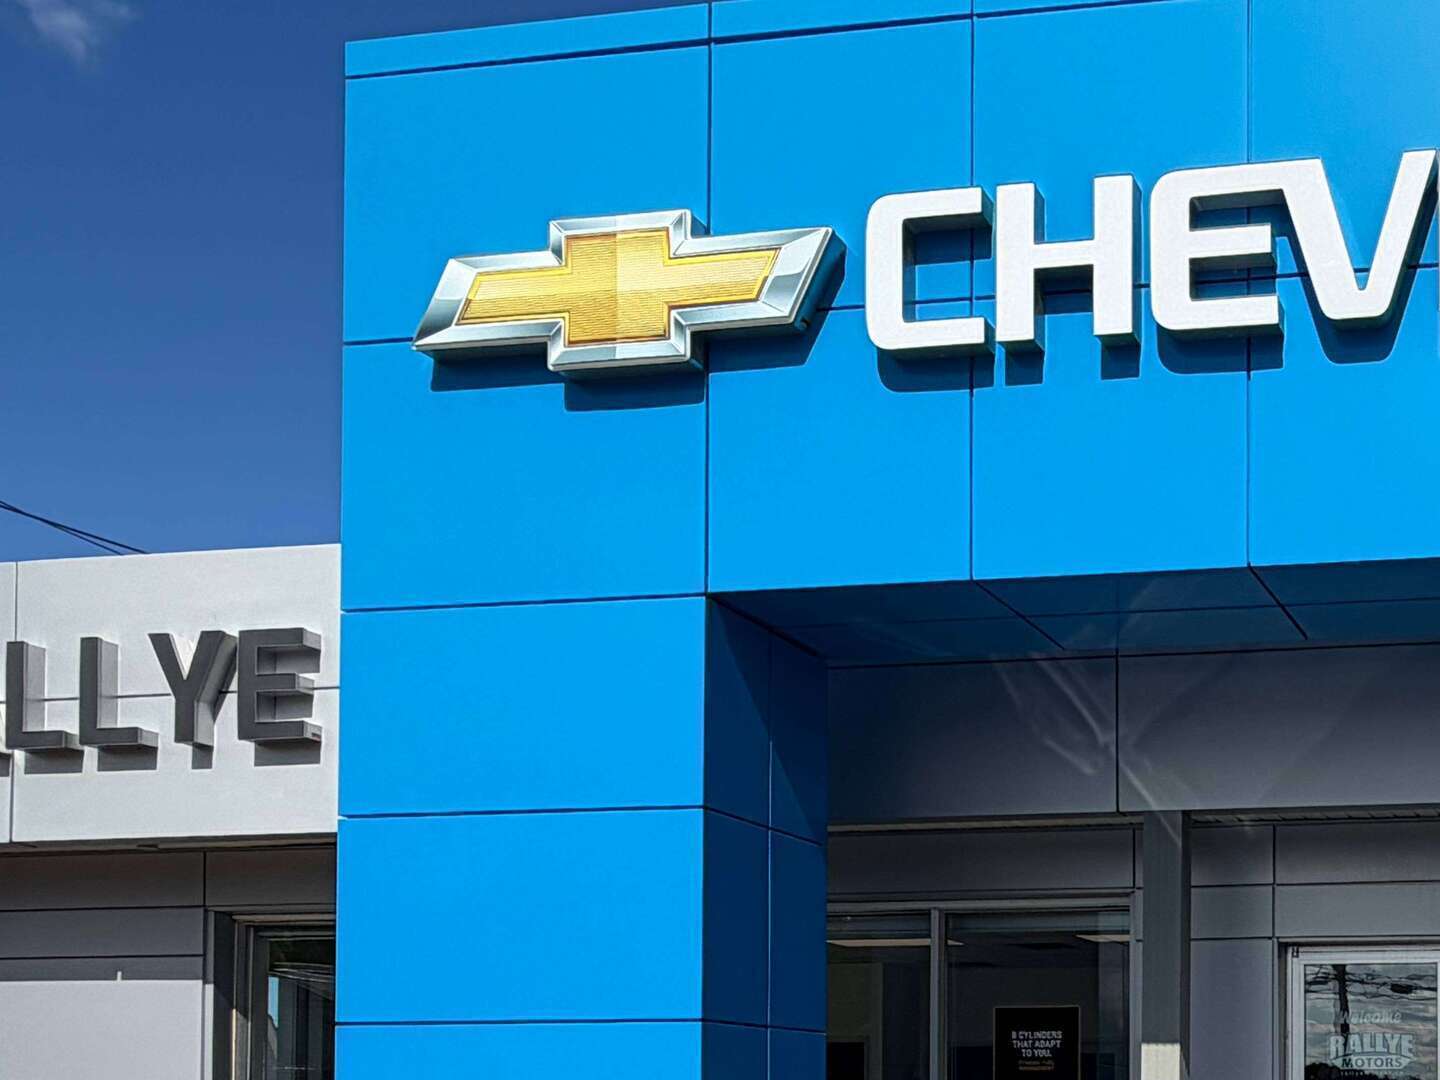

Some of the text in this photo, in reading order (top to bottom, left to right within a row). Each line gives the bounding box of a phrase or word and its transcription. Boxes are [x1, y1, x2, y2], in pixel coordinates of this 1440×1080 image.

[1018, 1030, 1063, 1039] CYLINDERS
[1012, 1040, 1061, 1048] THAT ADAPT
[1329, 1032, 1416, 1059] RALLYE
[1021, 1049, 1032, 1057] TO
[1342, 1057, 1402, 1068] MOTORS
